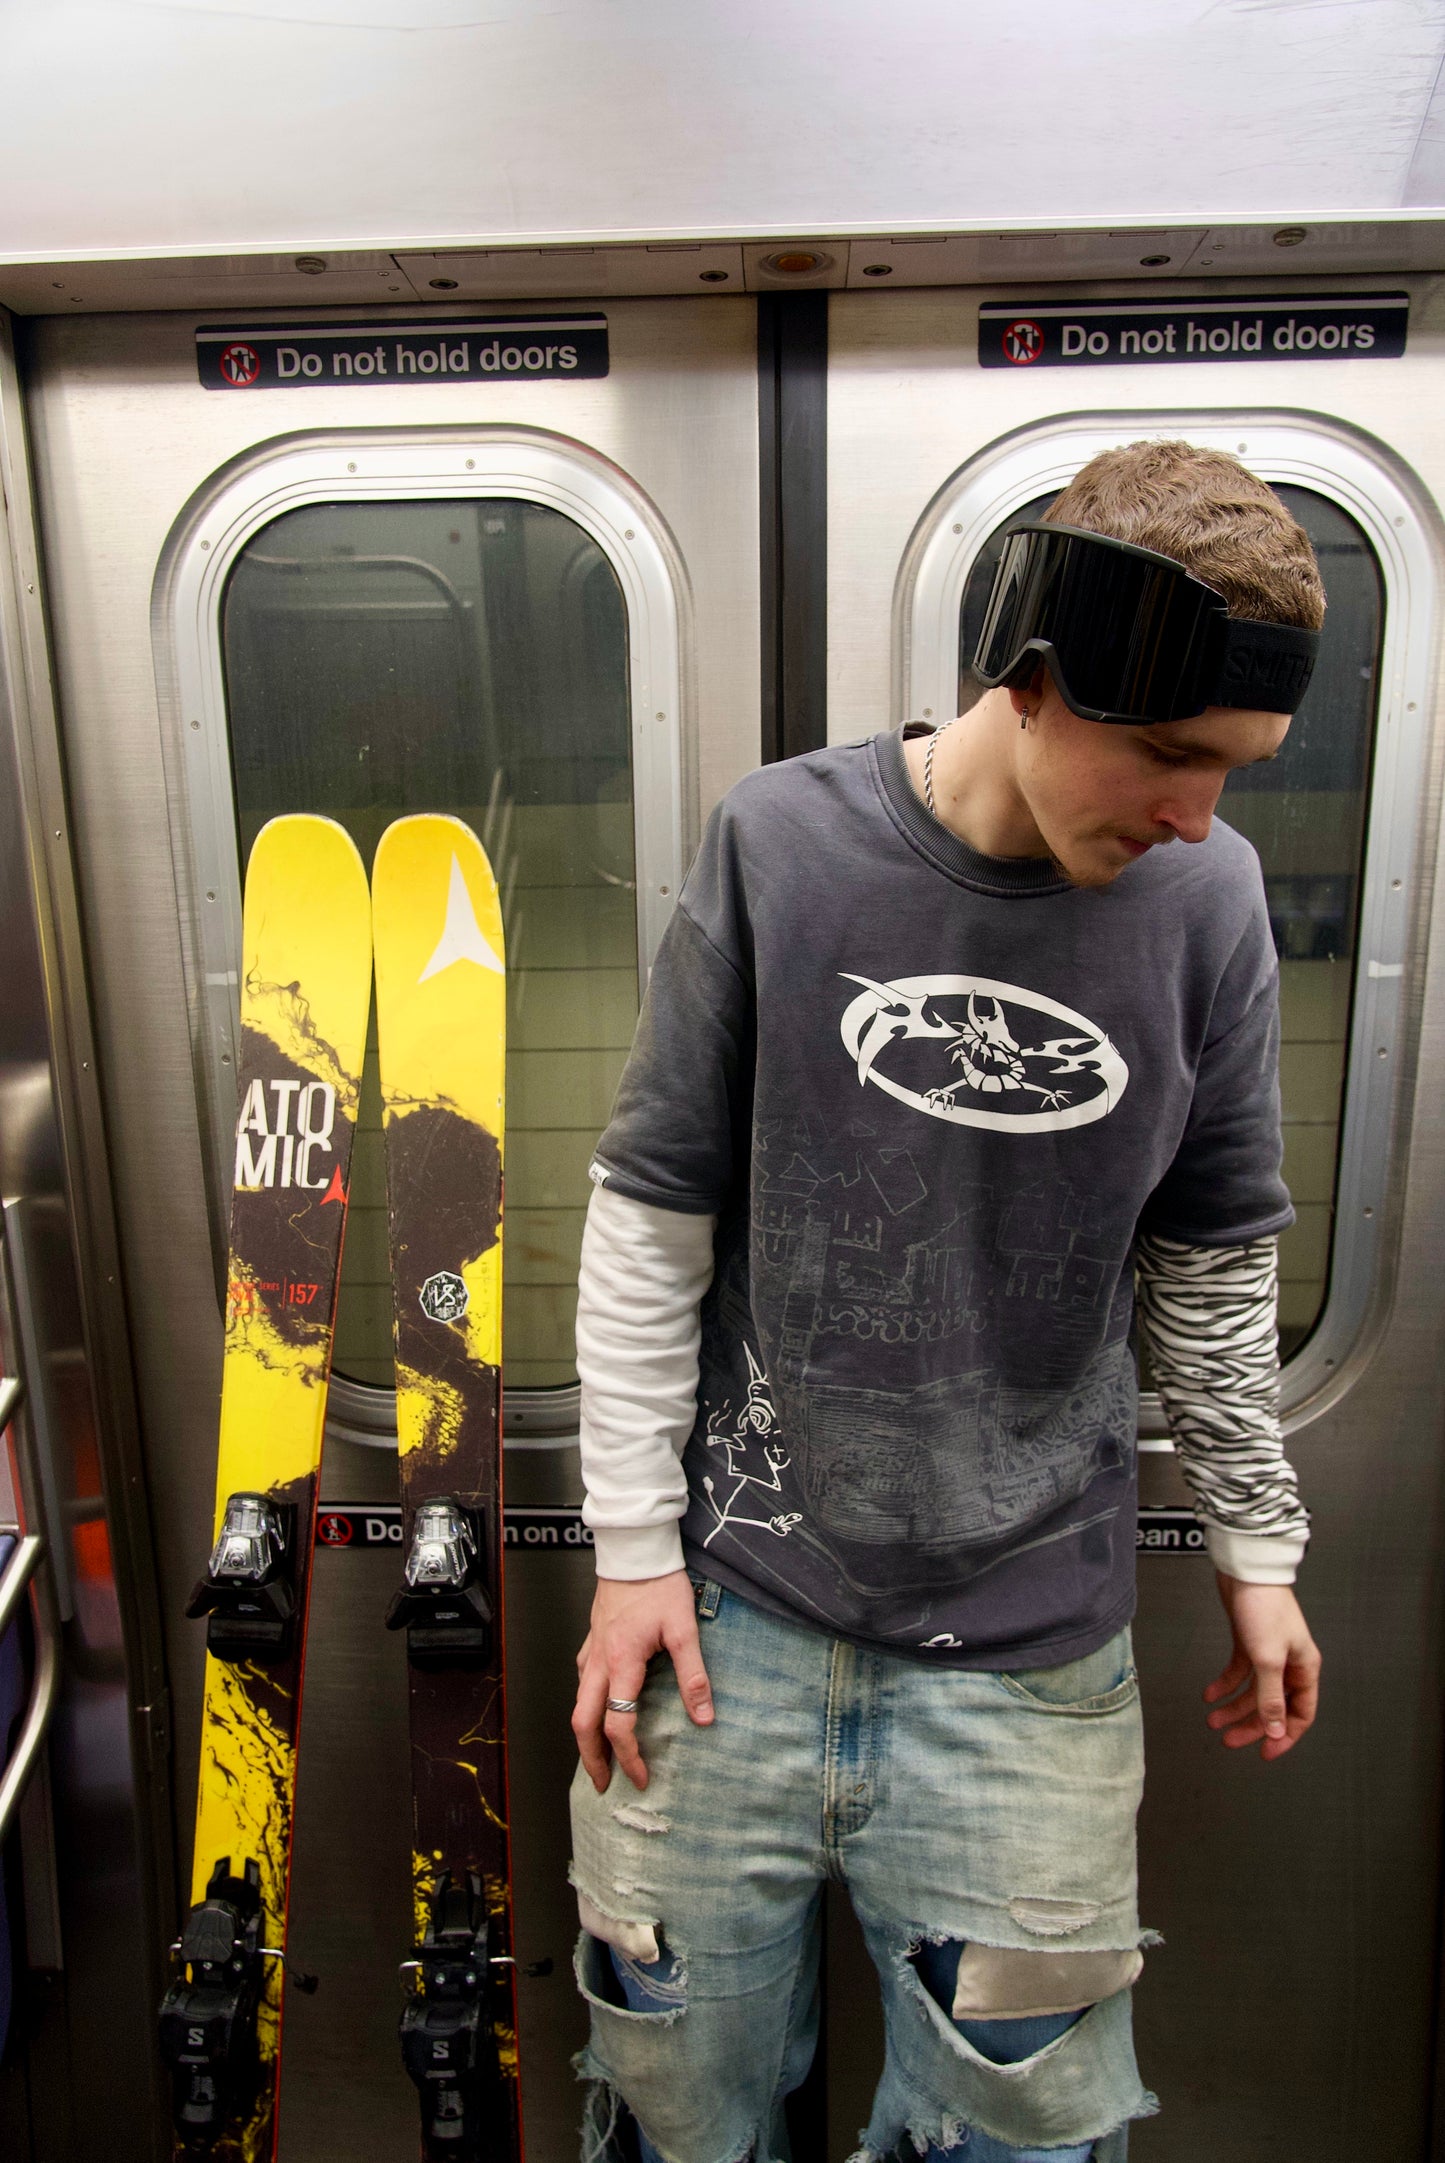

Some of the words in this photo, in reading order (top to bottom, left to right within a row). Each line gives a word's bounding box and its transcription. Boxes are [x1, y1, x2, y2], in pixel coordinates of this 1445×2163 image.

[1060, 325, 1109, 356] Do
[1119, 323, 1175, 354] not
[1186, 320, 1262, 352] hold
[1273, 319, 1375, 350] doors
[276, 347, 323, 378] Do
[333, 346, 386, 376] not
[396, 342, 469, 374] hold
[479, 341, 578, 372] doors
[288, 1284, 318, 1305] 157
[366, 1518, 403, 1541] Do
[523, 1526, 558, 1543] on
[563, 1522, 595, 1544] do
[1136, 1528, 1180, 1546] ean
[1185, 1529, 1206, 1547] o
